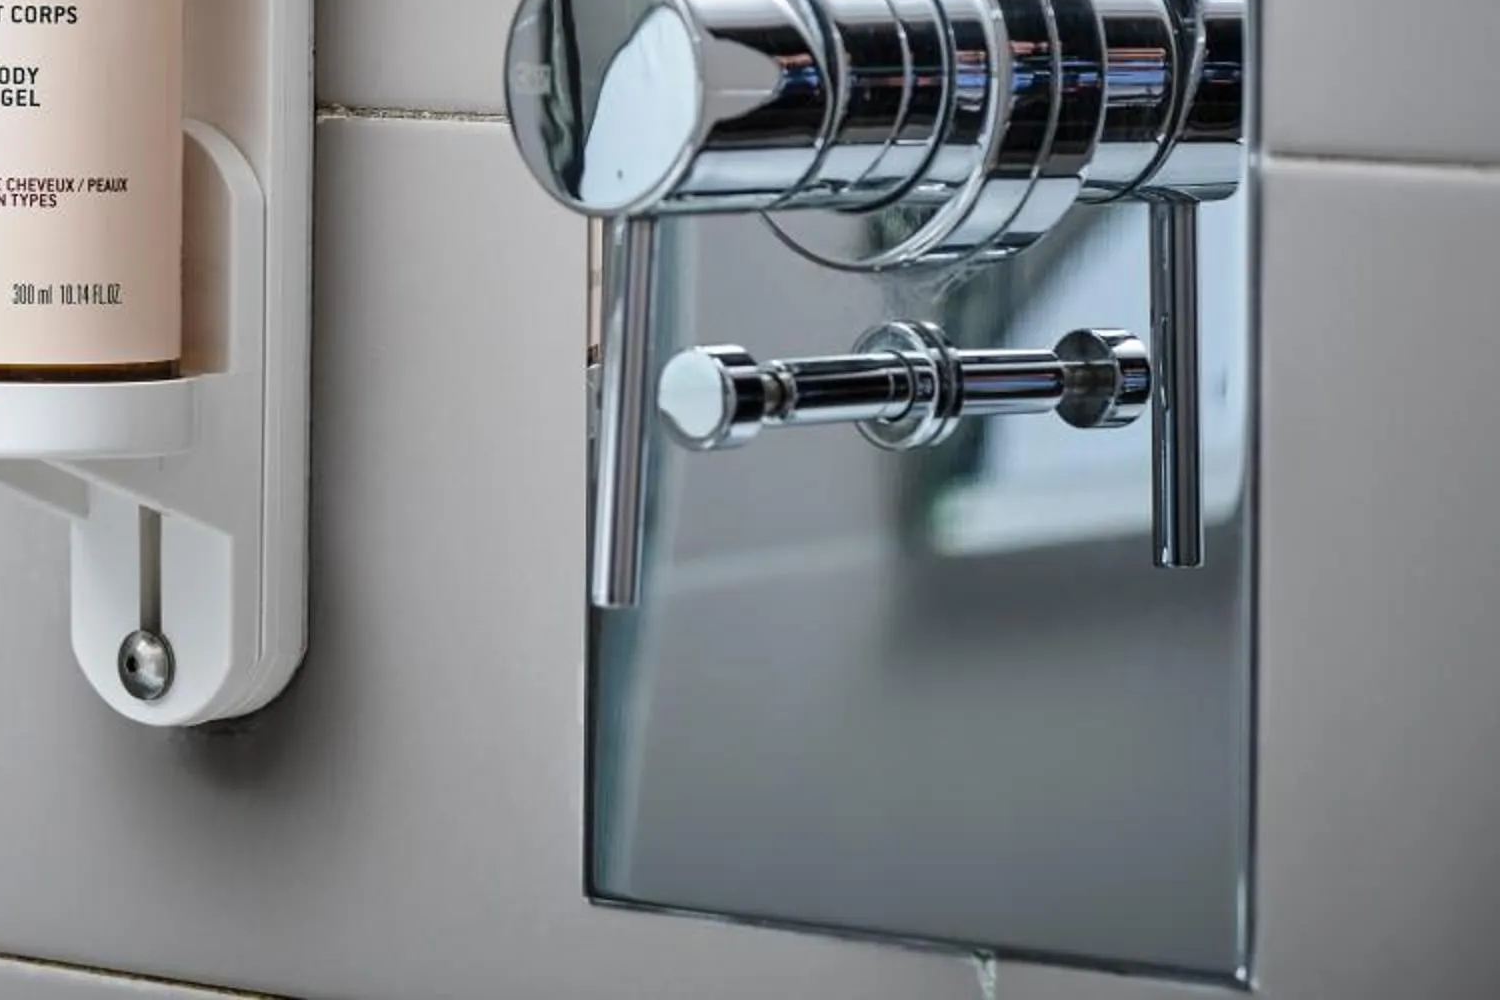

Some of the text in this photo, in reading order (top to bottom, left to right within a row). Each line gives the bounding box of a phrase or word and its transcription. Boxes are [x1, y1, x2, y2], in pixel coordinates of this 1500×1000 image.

[10, 4, 78, 25] CORPS
[0, 87, 41, 108] GEL
[5, 177, 75, 193] CHEVEUX
[87, 177, 128, 193] PEAUX
[10, 193, 58, 209] TYPES
[12, 283, 35, 305] 300
[37, 283, 53, 305] ml
[59, 283, 90, 305] 10.14
